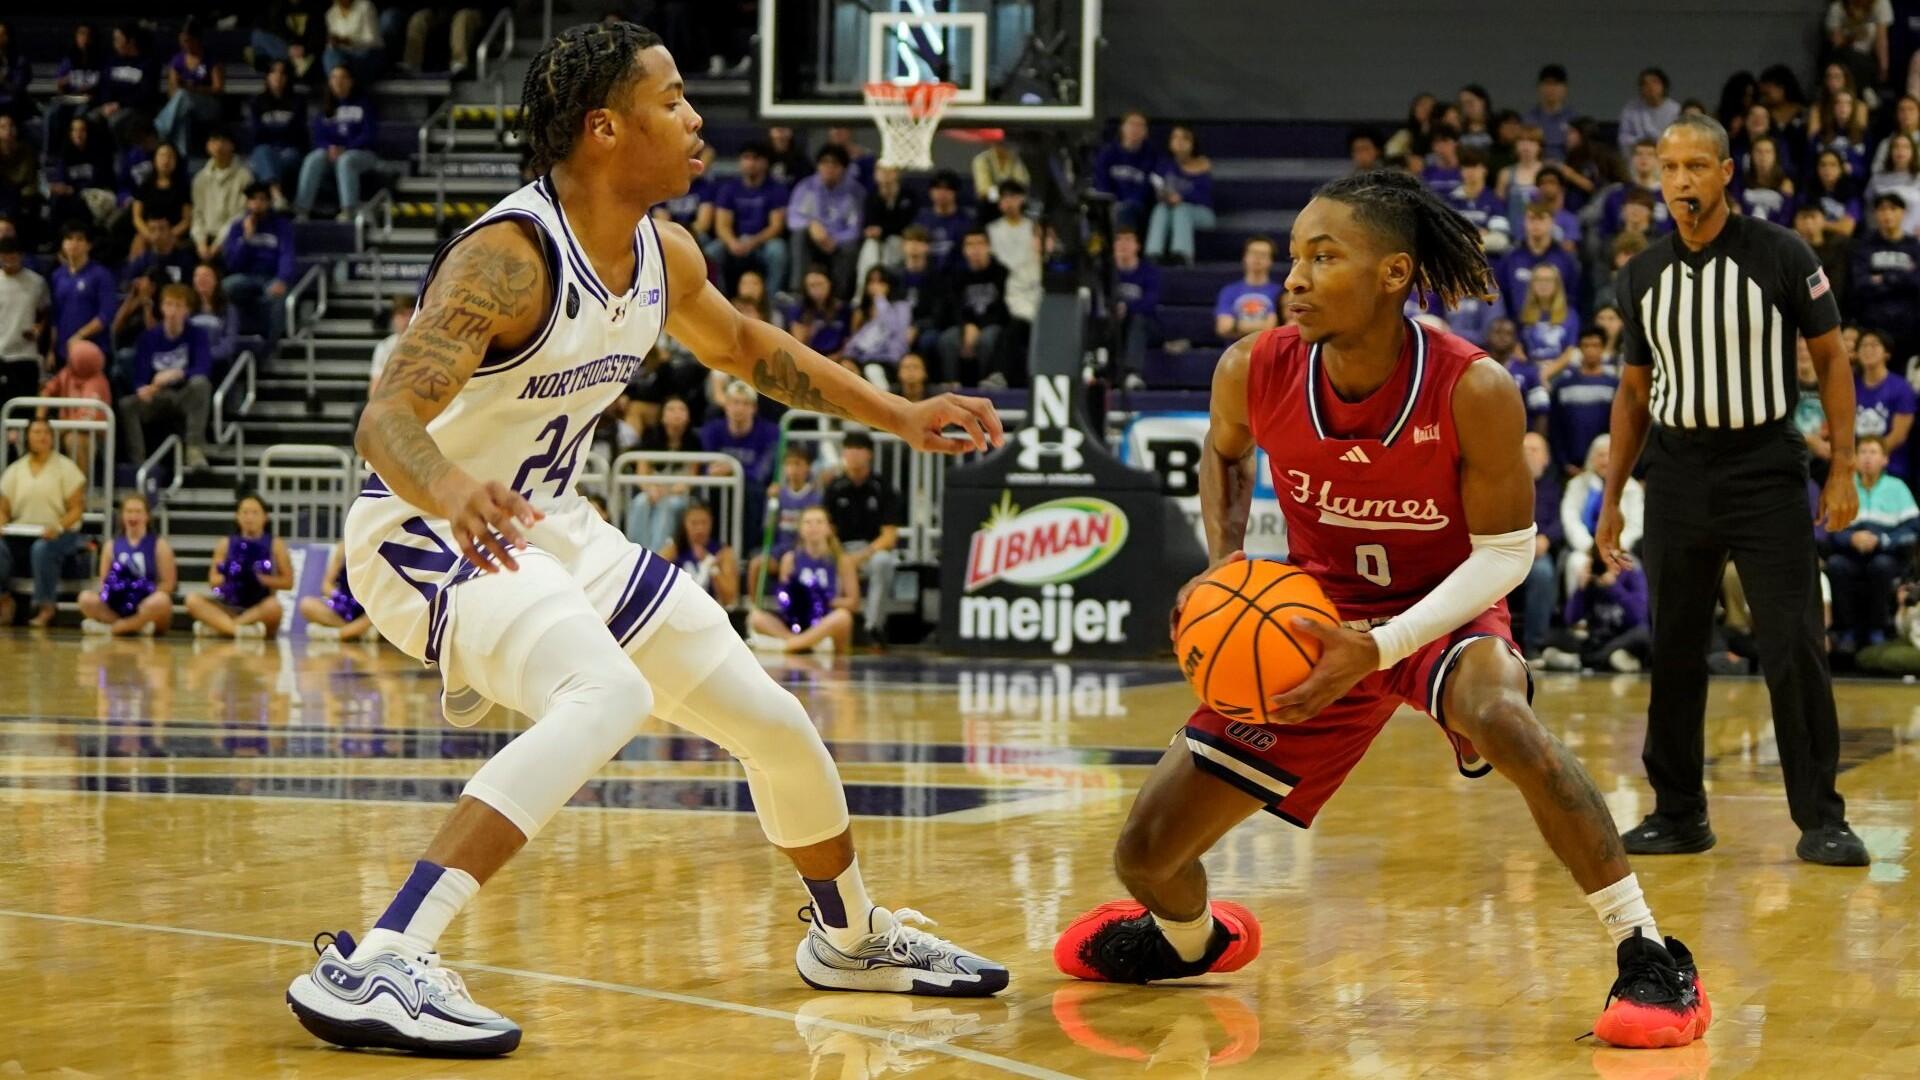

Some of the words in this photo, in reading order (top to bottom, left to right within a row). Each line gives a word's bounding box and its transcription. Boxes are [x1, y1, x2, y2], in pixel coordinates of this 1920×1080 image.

[1034, 373, 1070, 429] N
[510, 413, 601, 501] 24
[1287, 469, 1446, 526] Flames
[968, 512, 1113, 584] LIBMAN
[959, 583, 1131, 655] meijer
[1227, 720, 1277, 750] UIC
